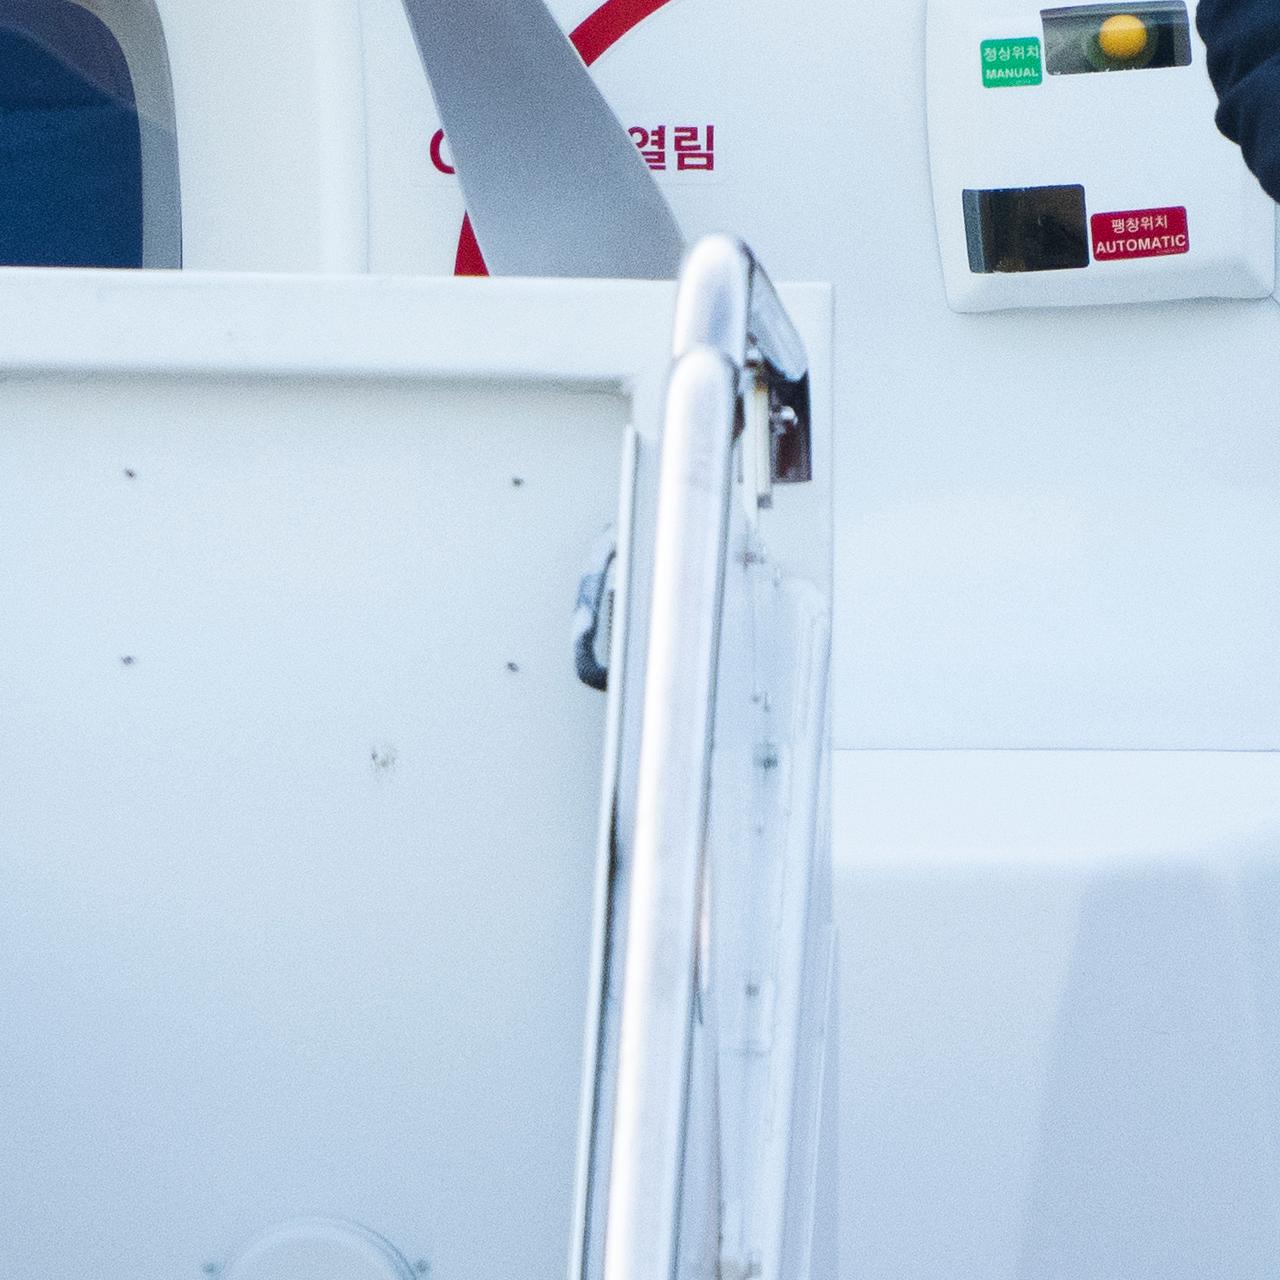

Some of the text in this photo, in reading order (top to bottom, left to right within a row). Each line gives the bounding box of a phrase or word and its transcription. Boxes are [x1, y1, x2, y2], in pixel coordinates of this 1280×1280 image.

[983, 45, 1040, 62] 정상위치
[985, 66, 1039, 79] MANUAL
[627, 124, 715, 171] 열림
[1110, 214, 1169, 234] 팽창위치
[1095, 234, 1187, 254] AUTOMATIC
